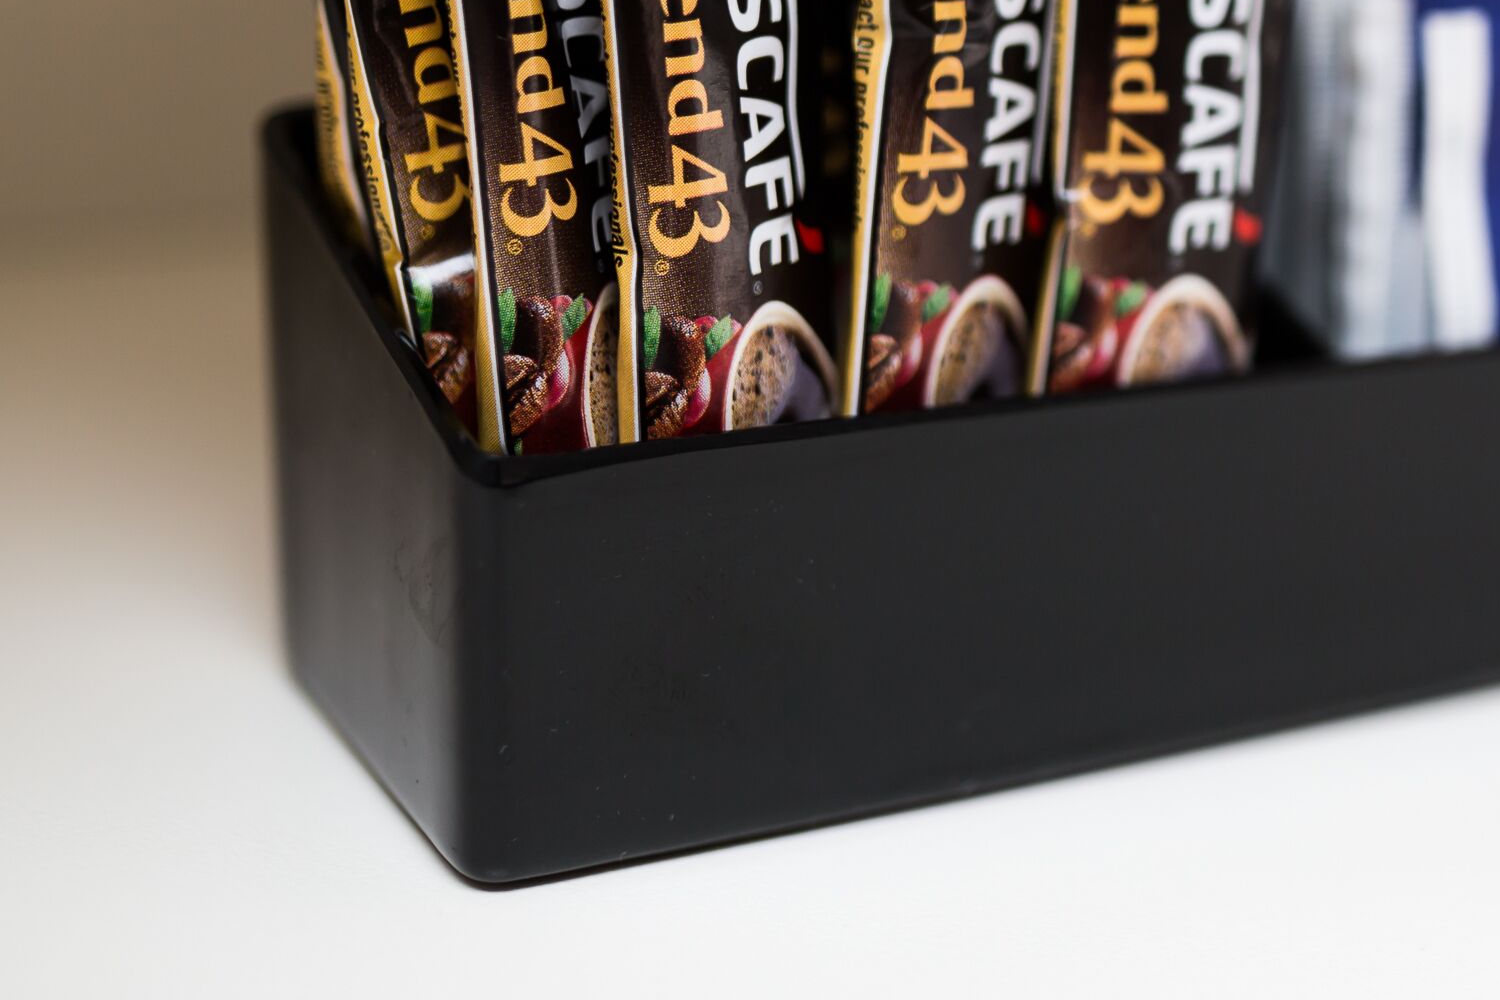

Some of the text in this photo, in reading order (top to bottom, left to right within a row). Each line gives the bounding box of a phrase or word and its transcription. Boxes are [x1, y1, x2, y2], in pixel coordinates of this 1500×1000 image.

[402, 111, 471, 222] 43
[499, 123, 578, 237] 43
[648, 144, 731, 258] 43
[891, 116, 969, 226] 43
[1079, 116, 1166, 225] 43
